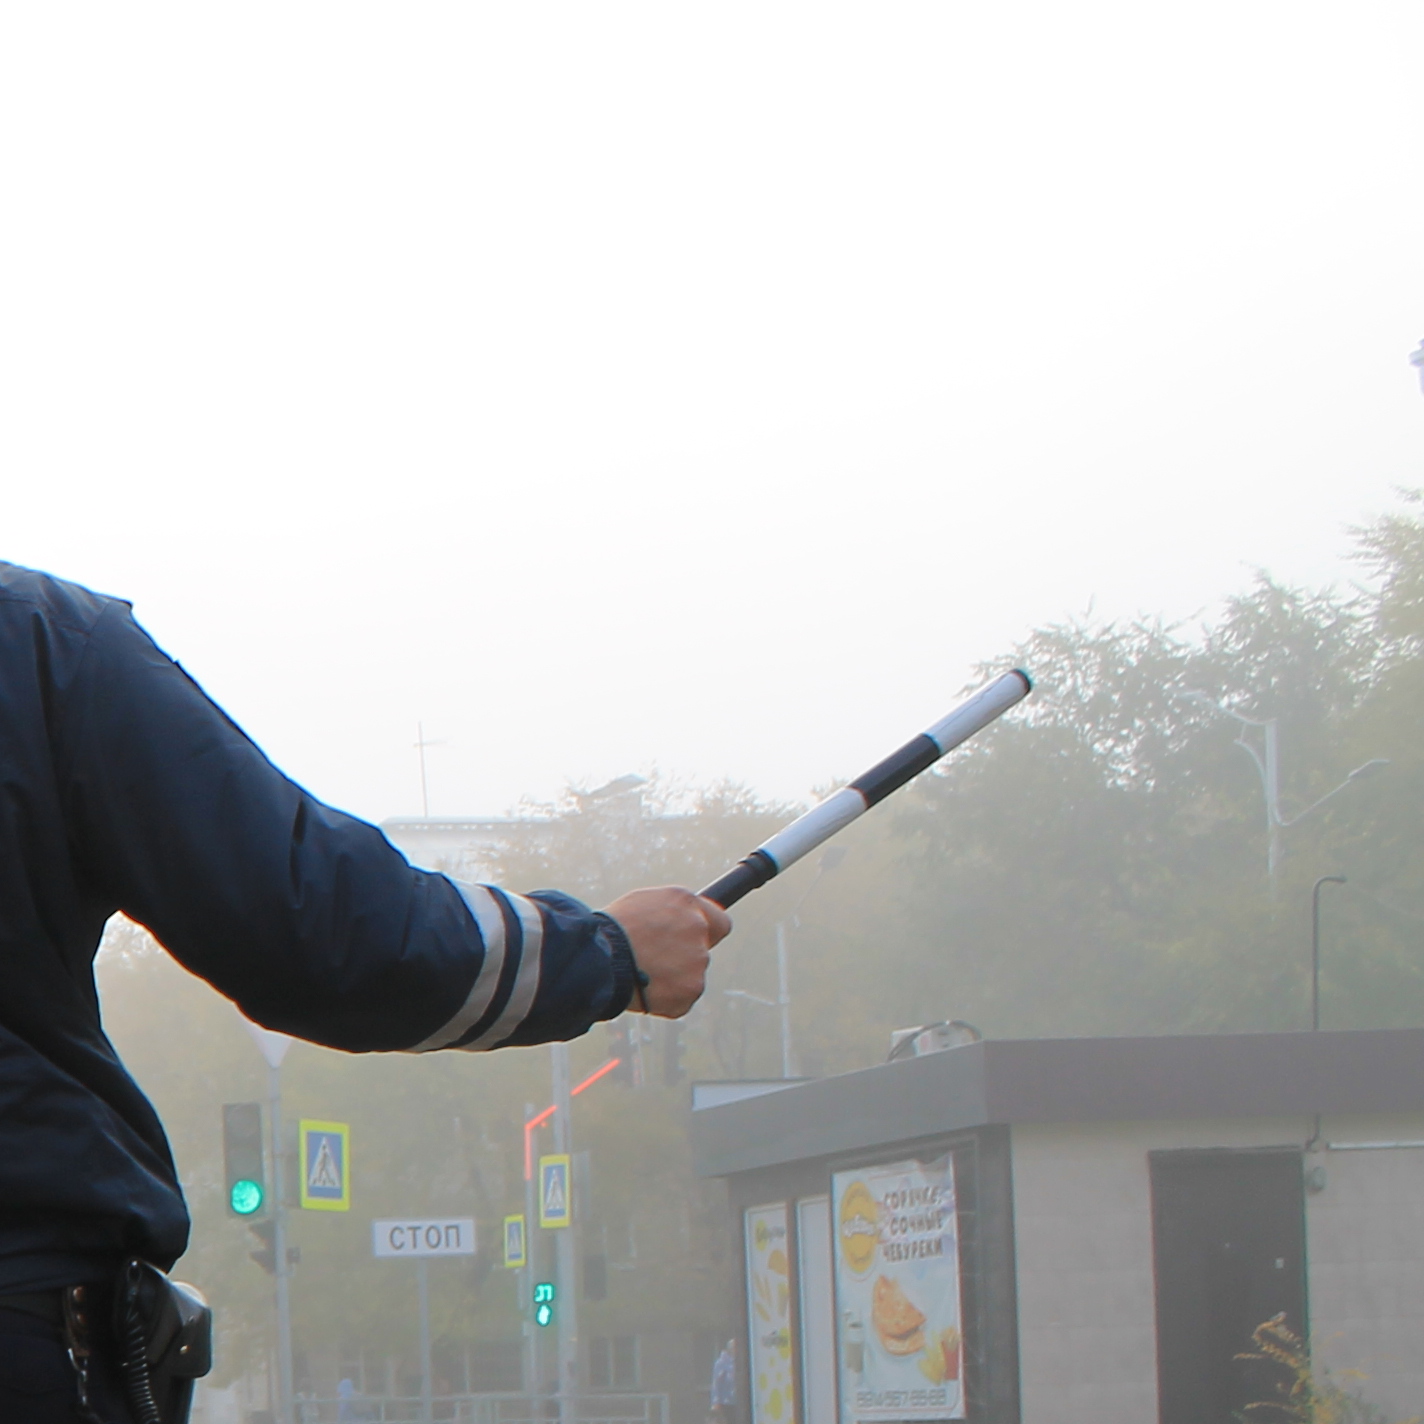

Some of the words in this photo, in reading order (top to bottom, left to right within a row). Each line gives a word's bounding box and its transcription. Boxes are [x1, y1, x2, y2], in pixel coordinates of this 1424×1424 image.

[890, 1210, 942, 1236] СОЧНЫЕ
[389, 1225, 460, 1250] СТОП
[882, 1237, 942, 1262] ЧЕБУРЕКИ
